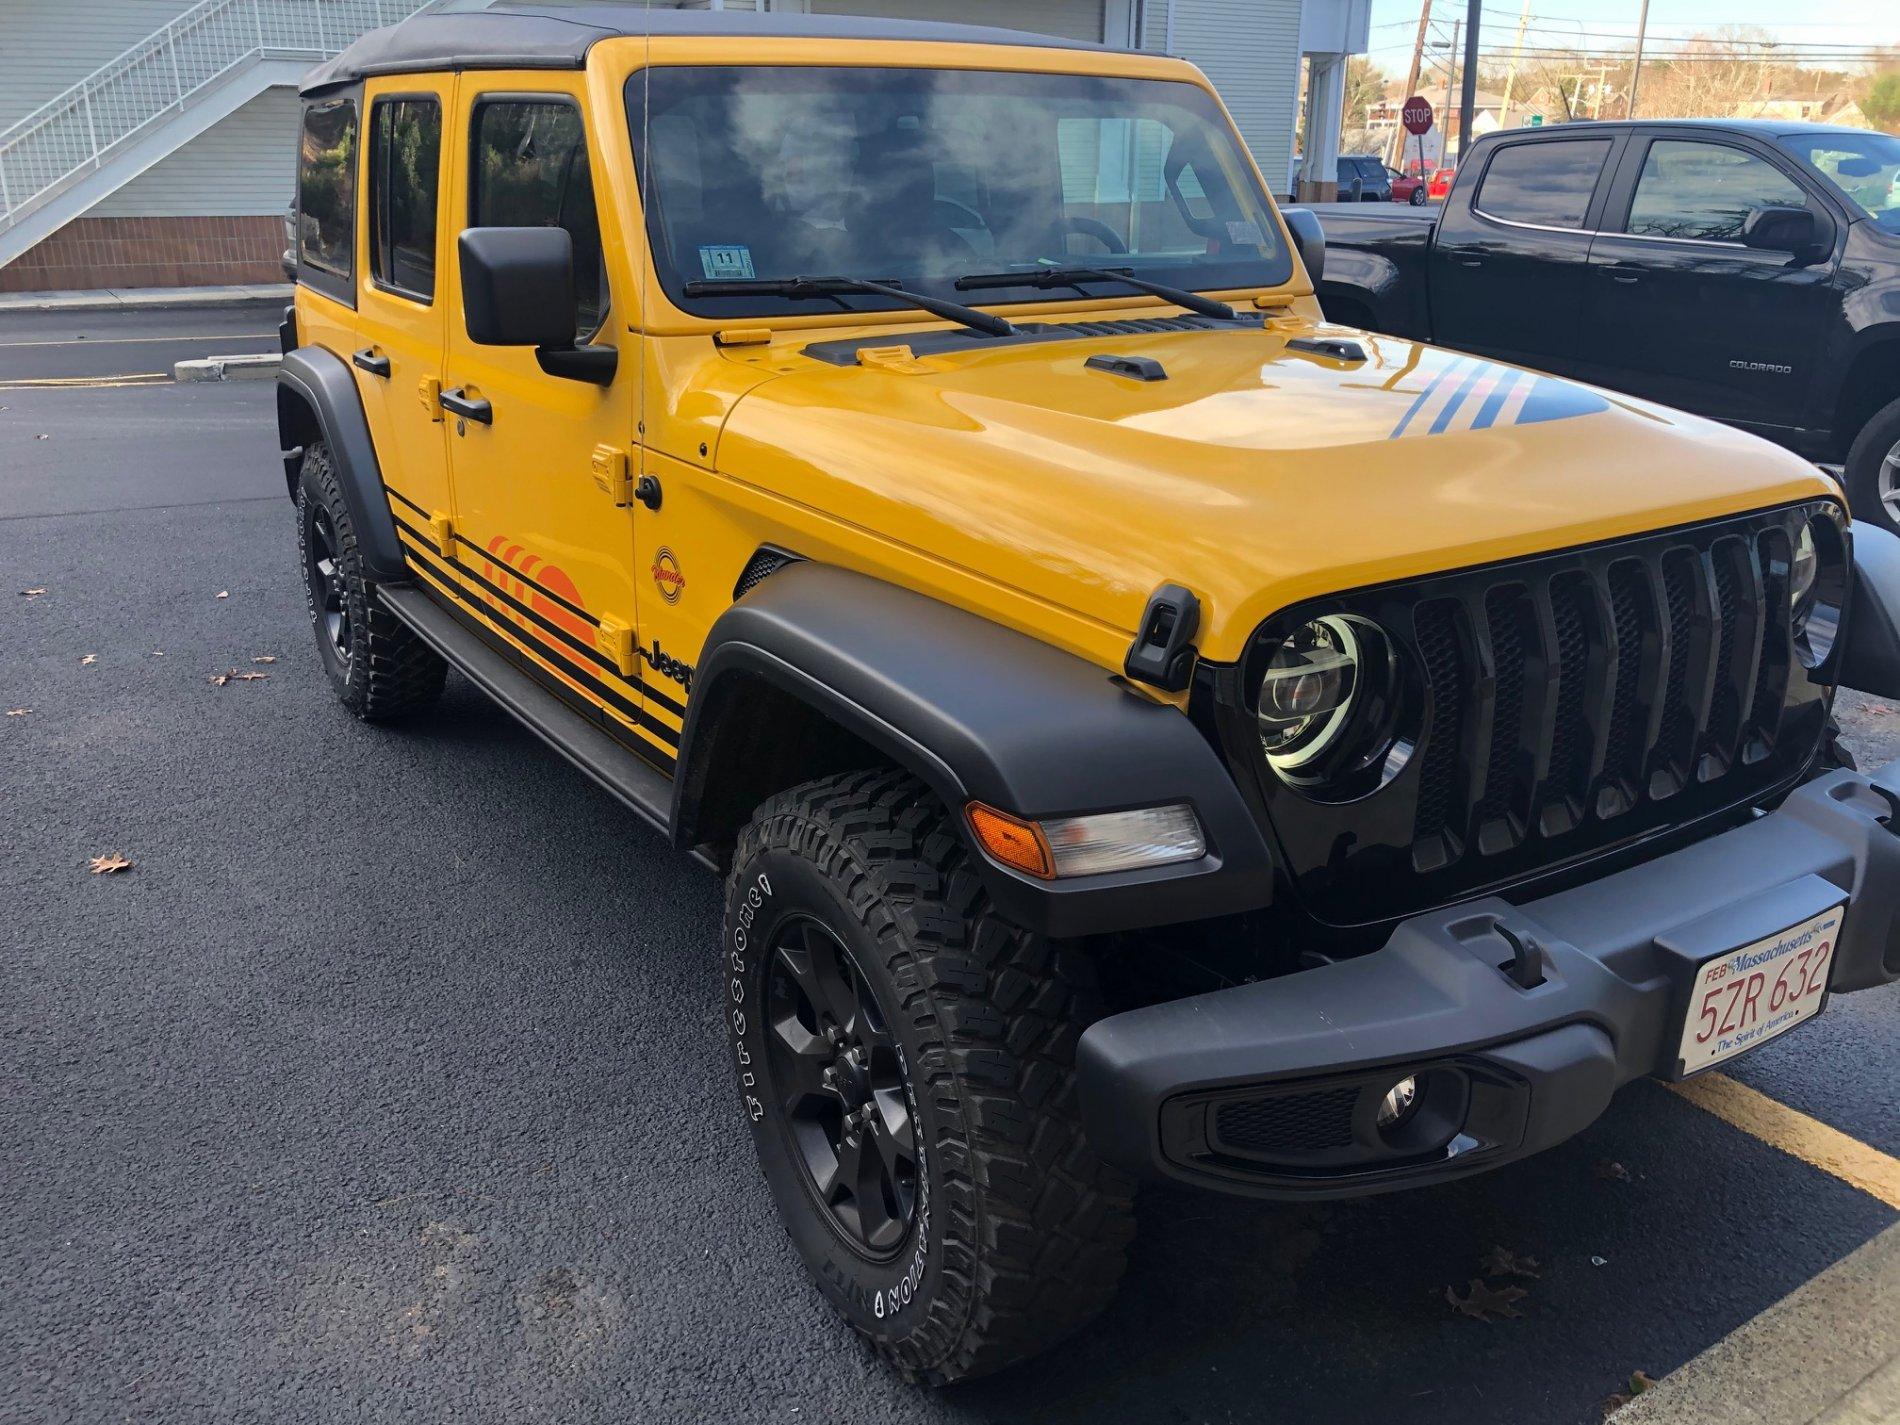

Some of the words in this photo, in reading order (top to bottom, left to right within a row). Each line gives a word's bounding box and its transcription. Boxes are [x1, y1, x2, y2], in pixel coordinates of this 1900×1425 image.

[1404, 107, 1431, 124] STOP
[717, 252, 733, 264] 11
[1729, 360, 1792, 374] COLORADO
[1705, 963, 1727, 985] FEB
[1732, 930, 1813, 975] Massachusetts
[730, 887, 763, 1122] Firestone
[1696, 972, 1765, 1043] 5ZR
[1769, 941, 1831, 1012] 632
[1717, 1039, 1734, 1053] The
[1735, 1027, 1757, 1047] Spirit
[1756, 1023, 1766, 1037] of
[1765, 1011, 1795, 1031] America
